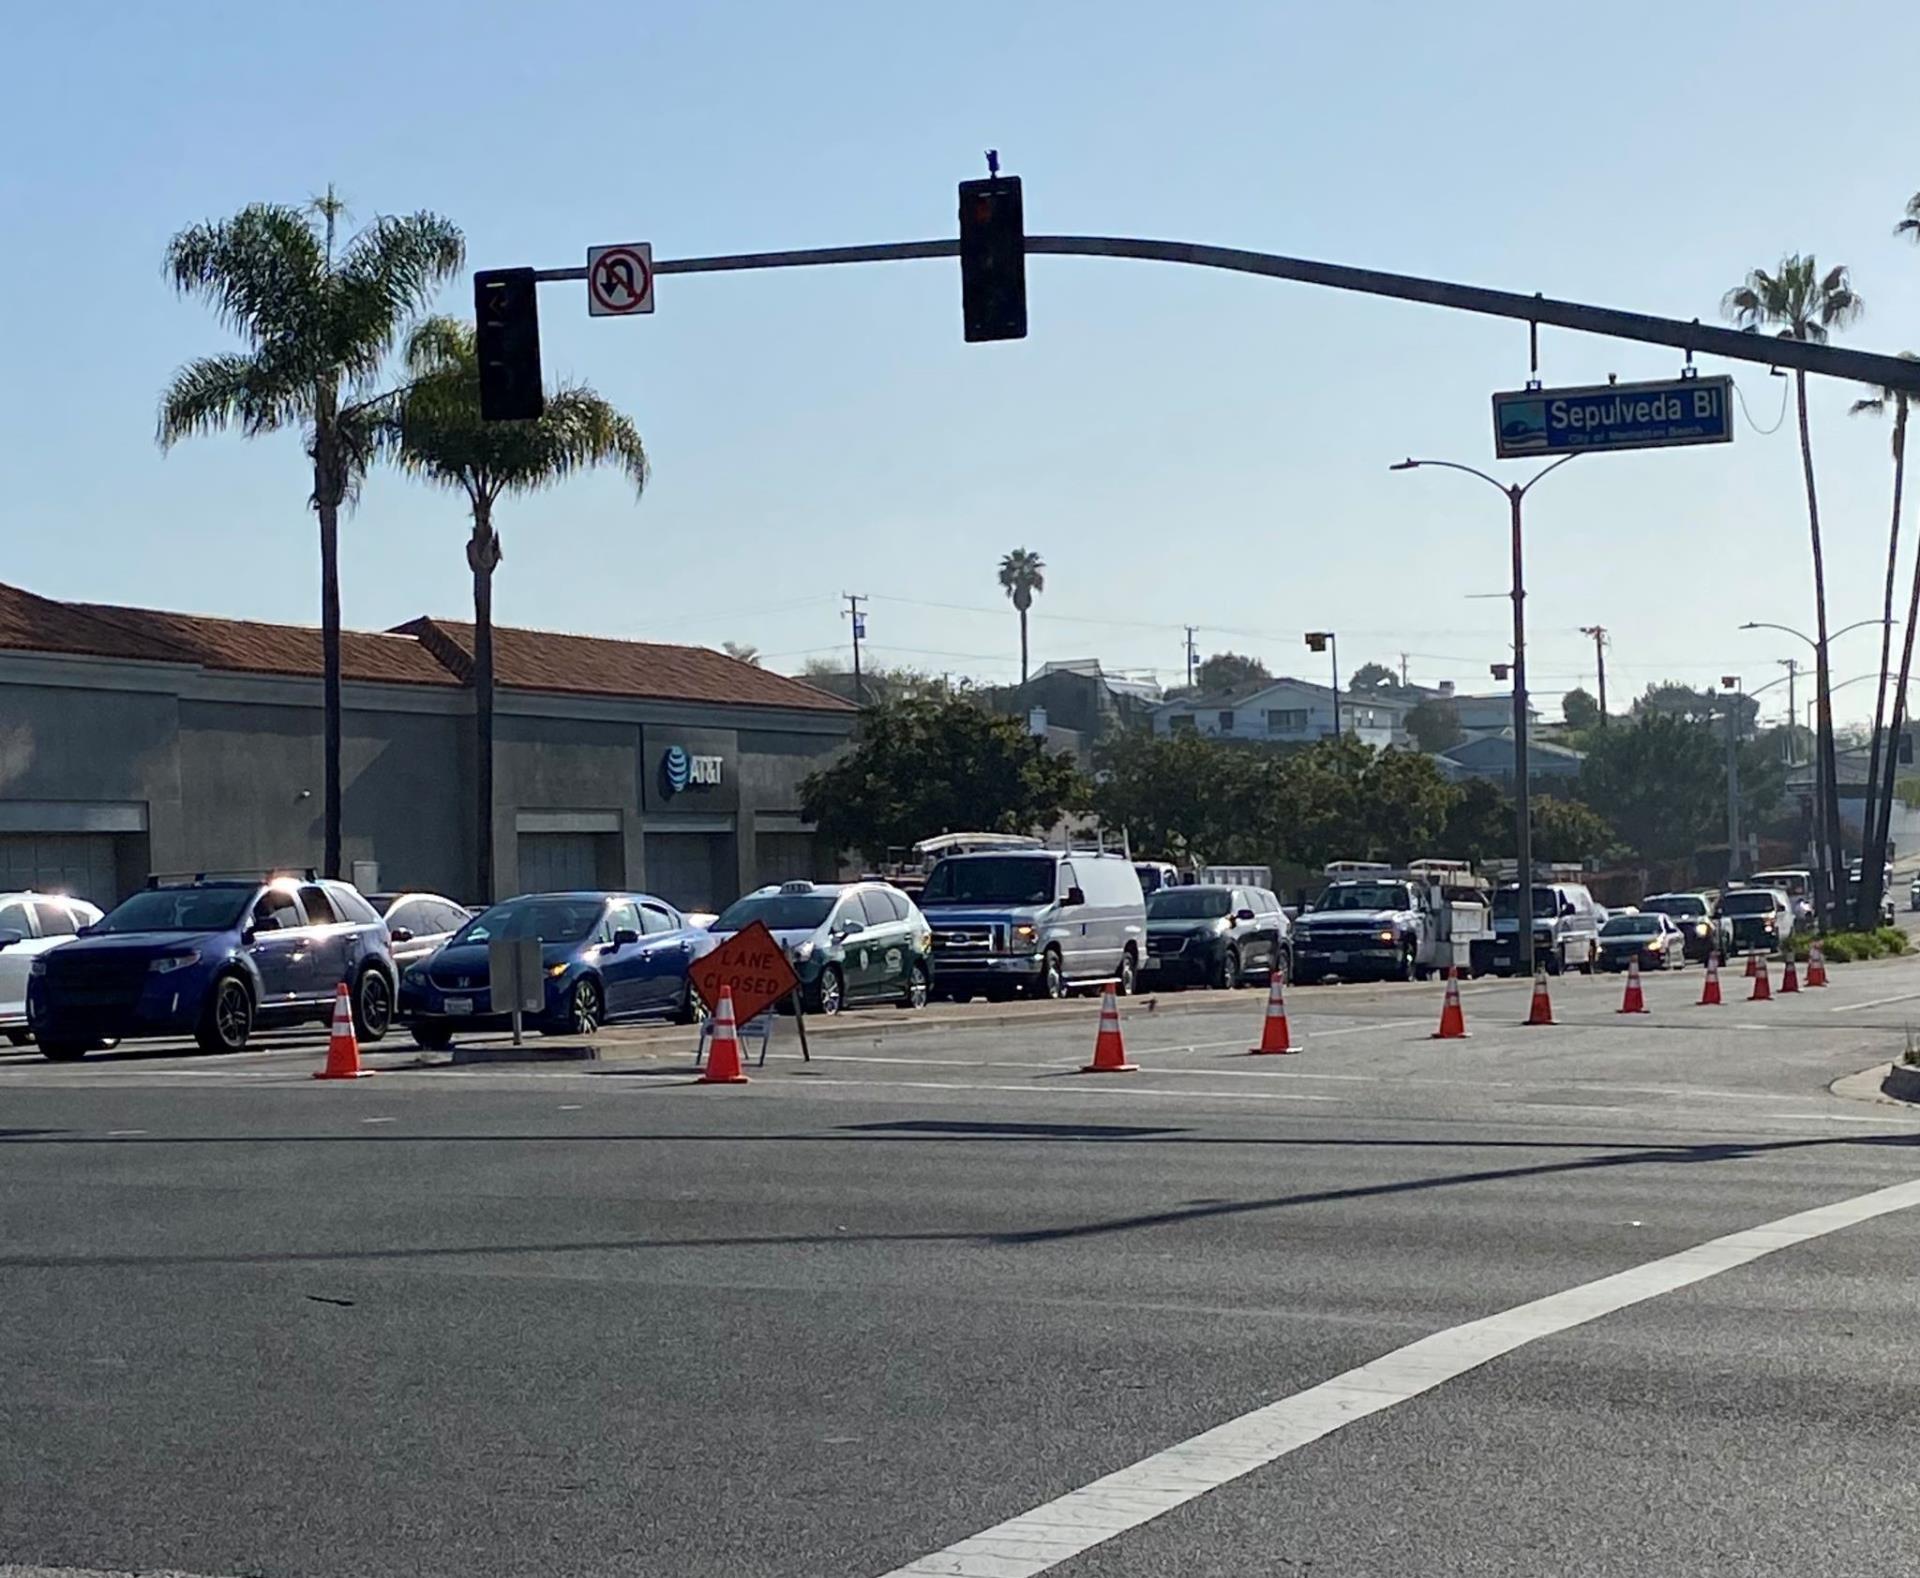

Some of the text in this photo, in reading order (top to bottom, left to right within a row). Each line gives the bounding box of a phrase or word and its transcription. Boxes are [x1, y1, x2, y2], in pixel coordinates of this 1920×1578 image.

[1551, 390, 1718, 431] Sepulveda Bl
[689, 755, 723, 784] AT&T
[721, 949, 774, 969] LANE
[704, 972, 779, 995] CLOSED
